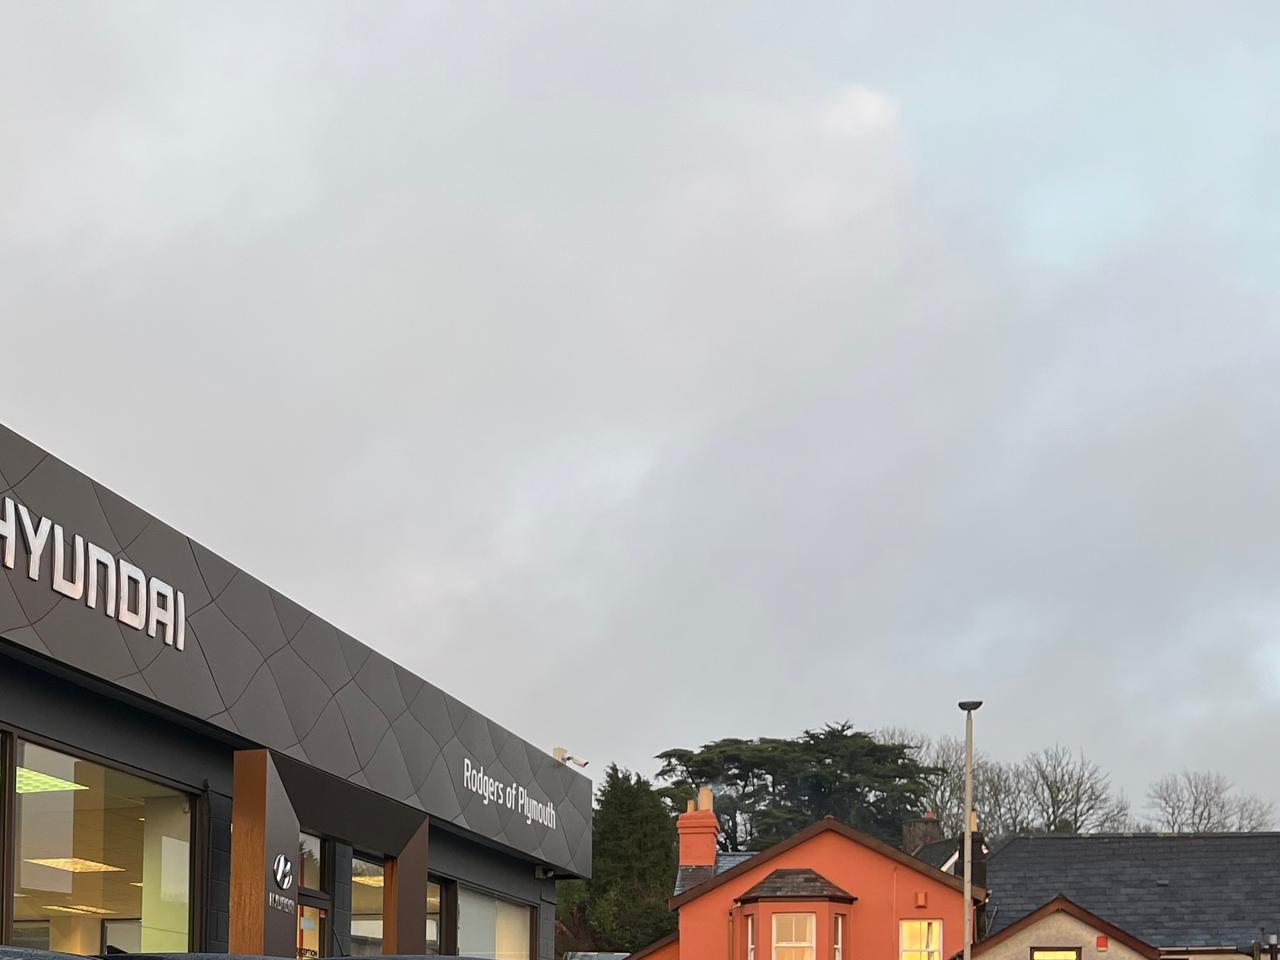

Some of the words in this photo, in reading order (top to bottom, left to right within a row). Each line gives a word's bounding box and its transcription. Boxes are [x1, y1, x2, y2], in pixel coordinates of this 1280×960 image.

[463, 757, 504, 805] Rodgers
[506, 782, 517, 810] of
[518, 785, 556, 830] Plymouth
